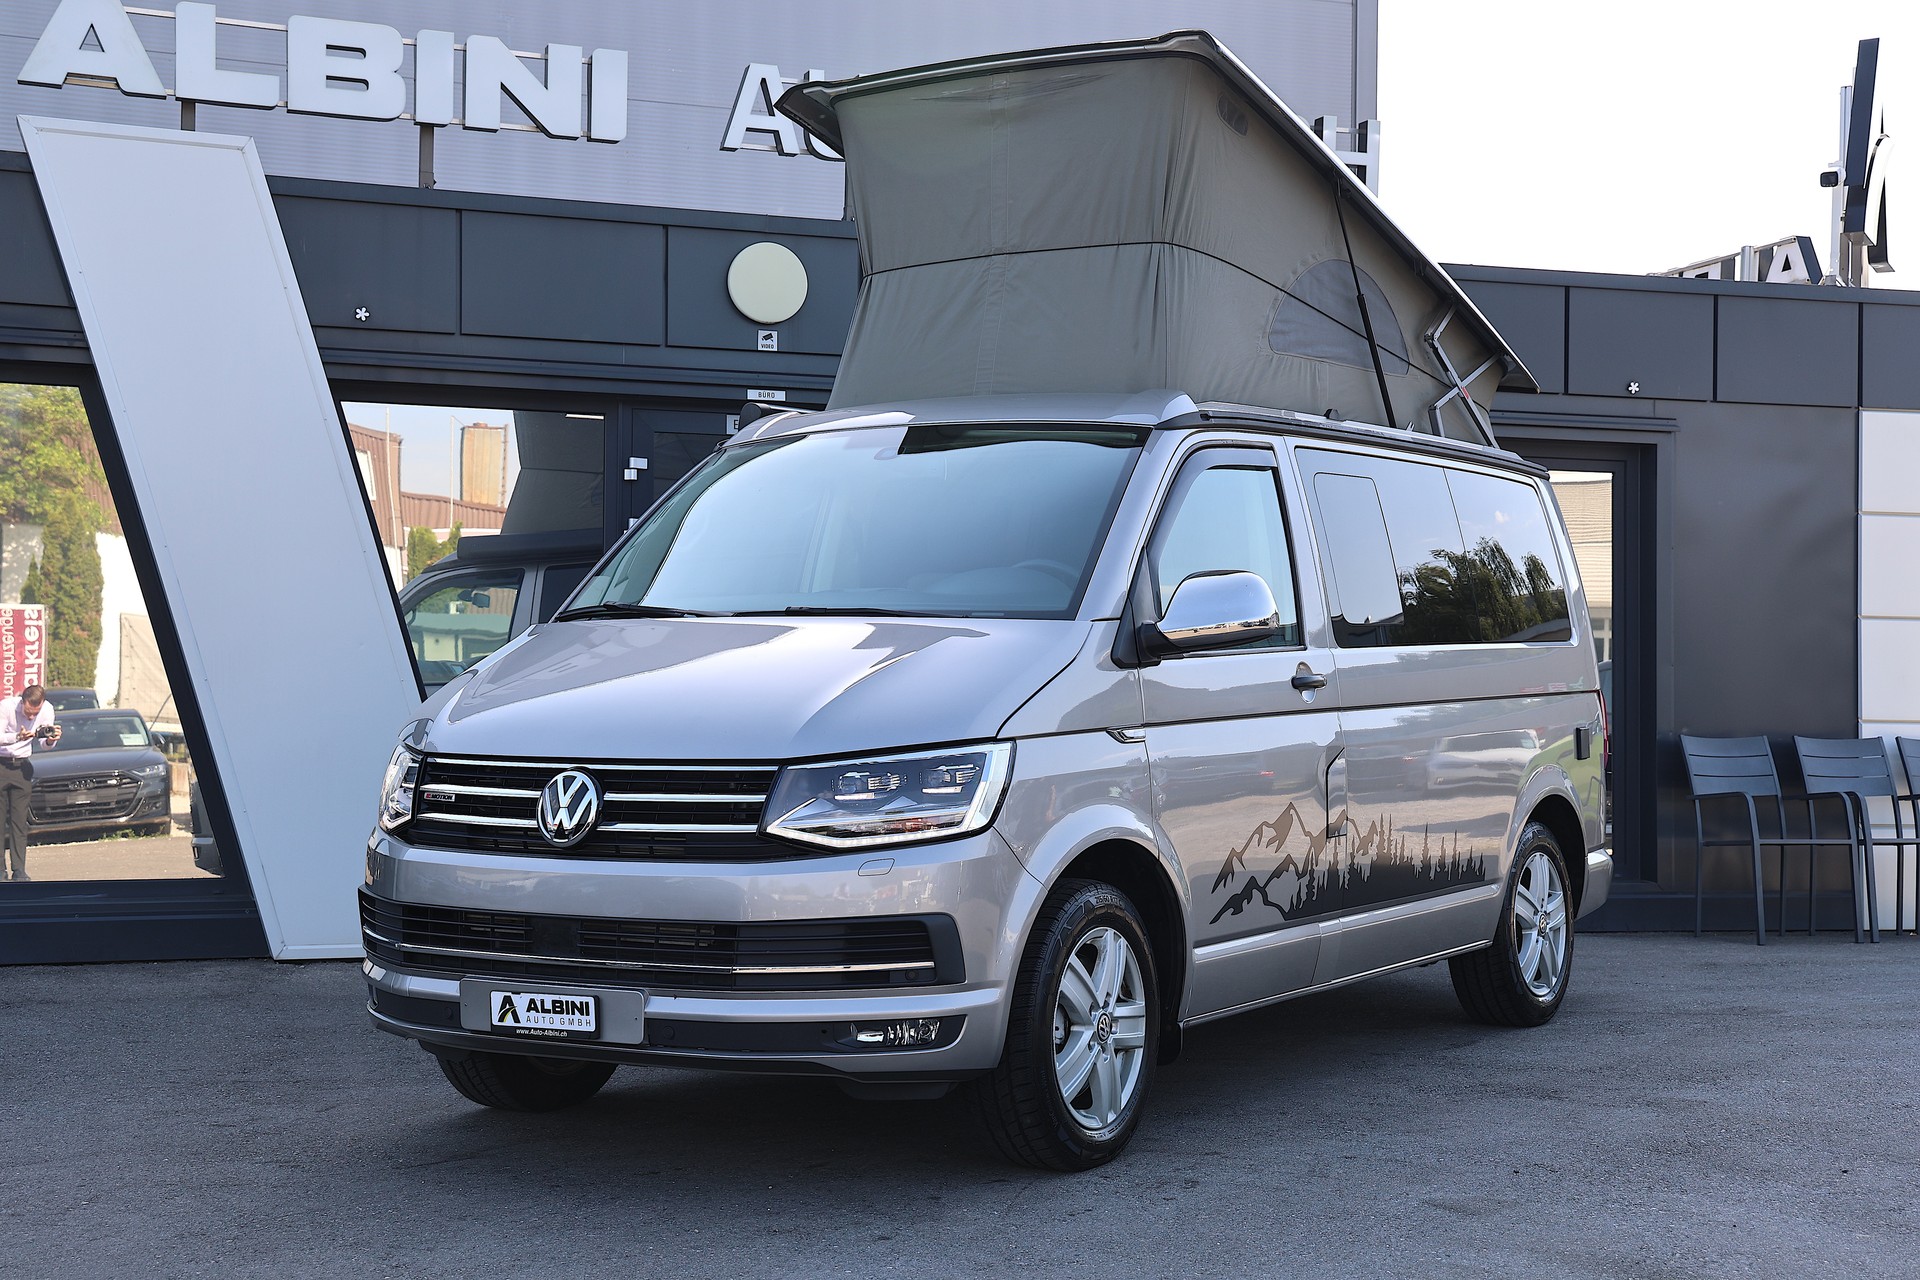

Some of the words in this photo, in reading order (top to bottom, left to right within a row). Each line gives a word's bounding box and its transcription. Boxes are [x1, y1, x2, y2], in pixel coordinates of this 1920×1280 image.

[17, 0, 628, 144] ALBINI
[758, 391, 775, 399] BÜRO
[526, 998, 590, 1016] ALBINI
[526, 1015, 554, 1025] AUTO
[560, 1017, 591, 1027] GMBH
[516, 1028, 568, 1038] www.Auto-Albini.ch
